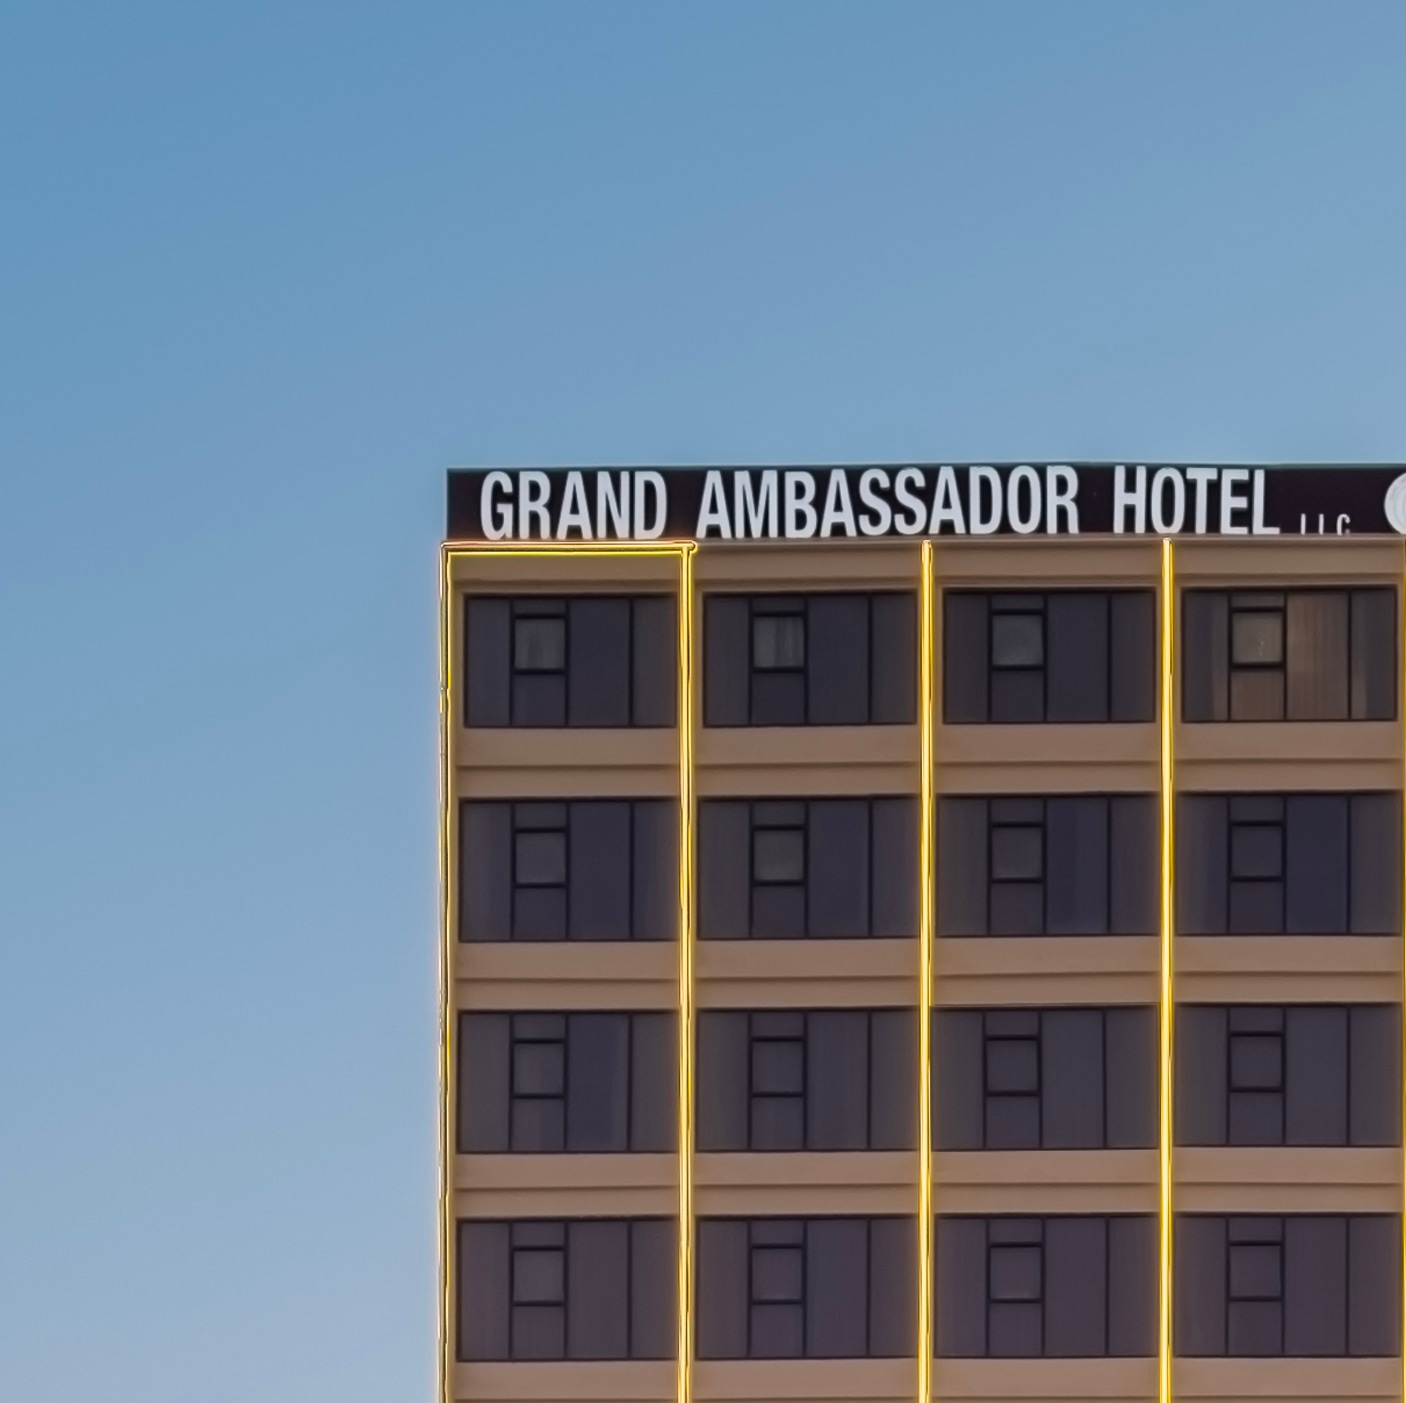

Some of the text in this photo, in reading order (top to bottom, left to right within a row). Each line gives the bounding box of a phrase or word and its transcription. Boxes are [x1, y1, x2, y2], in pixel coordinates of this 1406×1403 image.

[480, 470, 667, 540] GRAND
[695, 465, 1079, 539] AMBASSADOR
[1113, 464, 1280, 535] HOTEL
